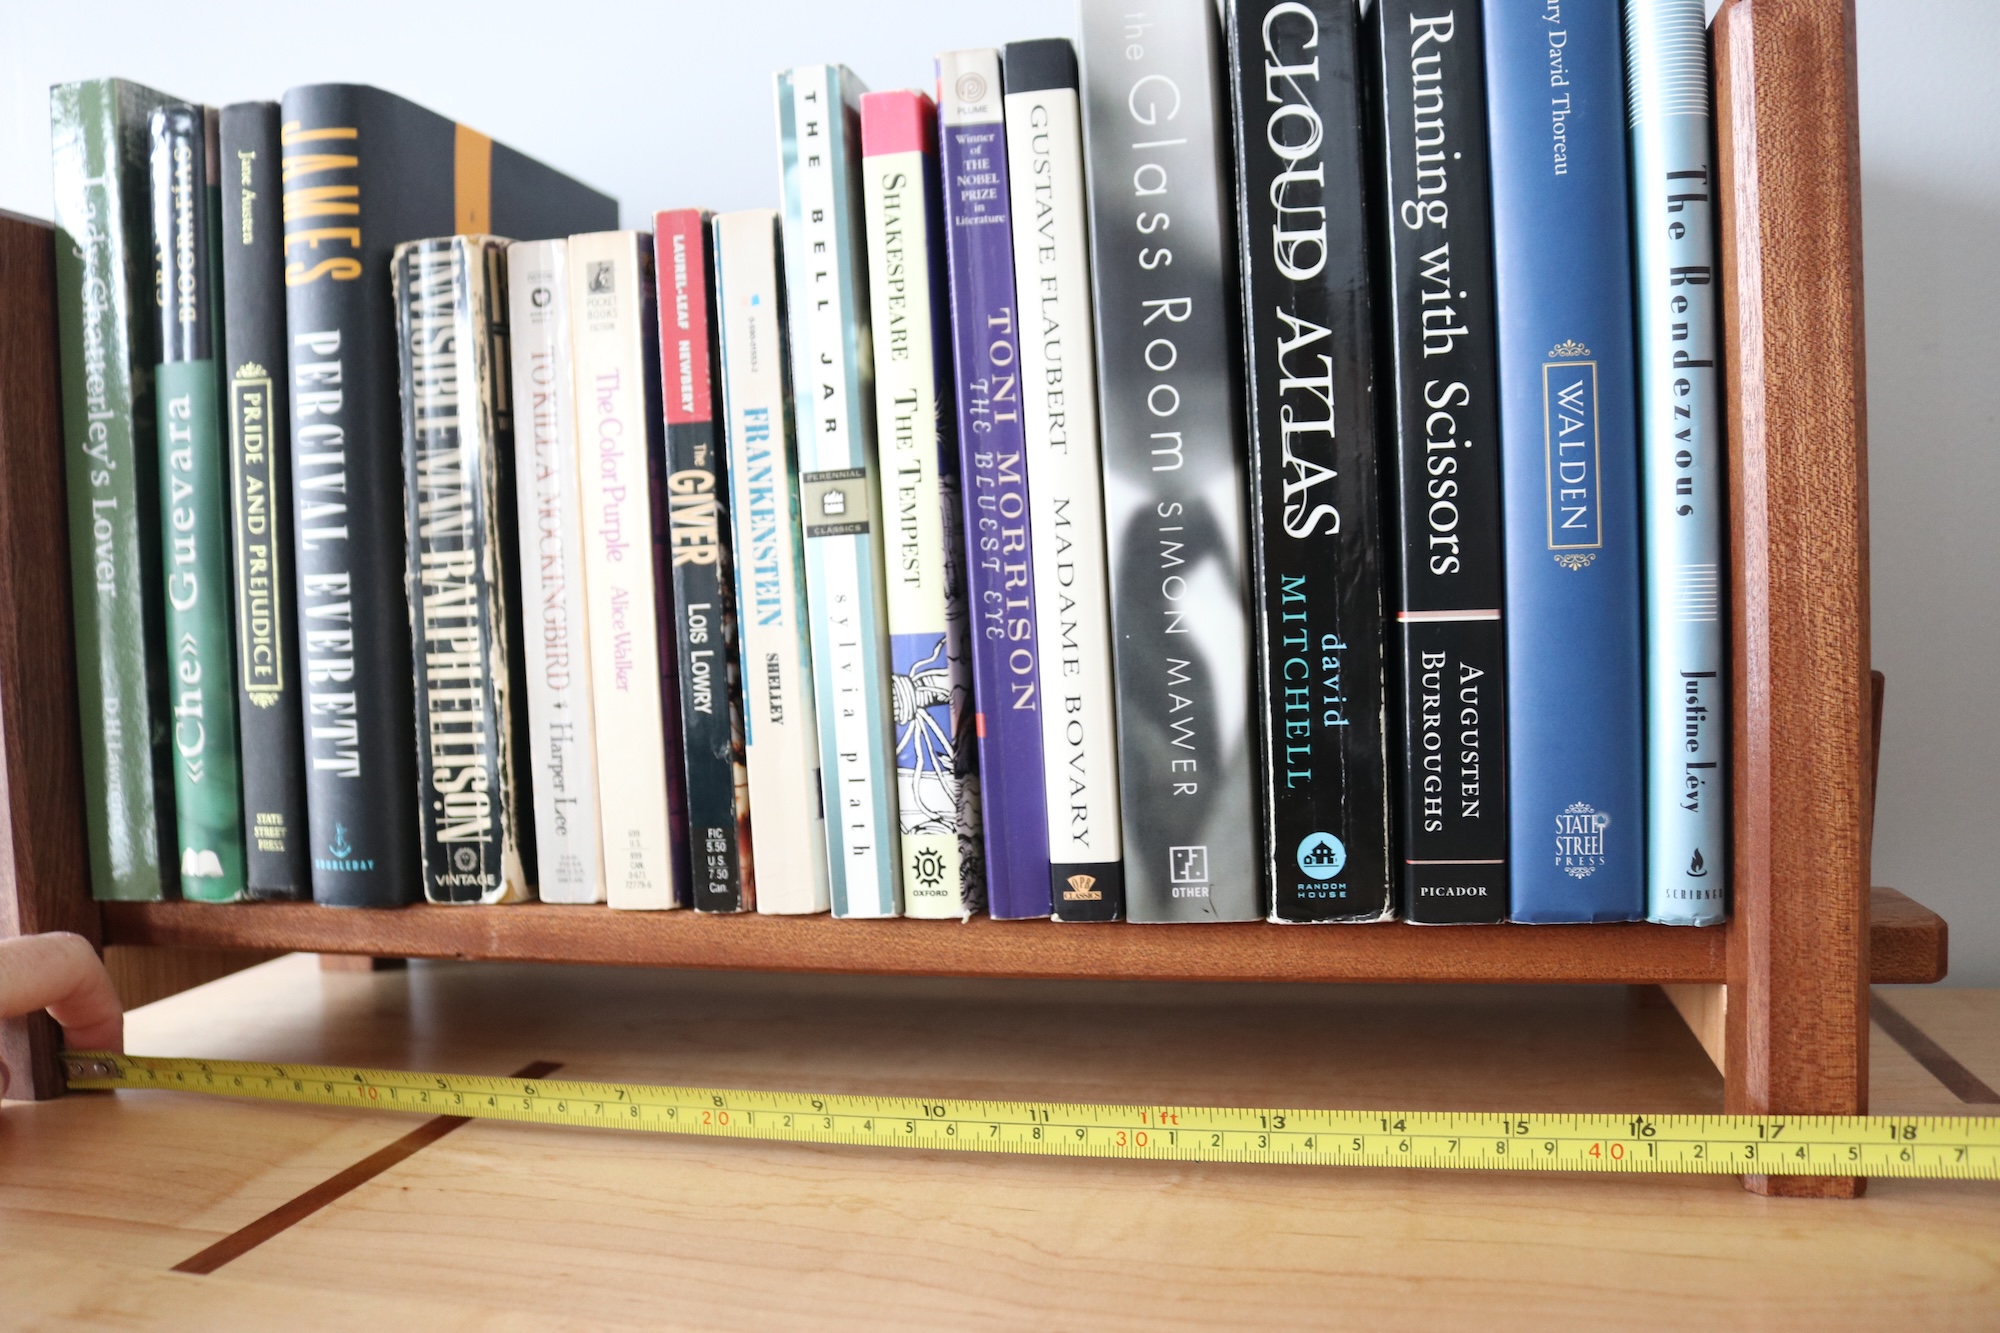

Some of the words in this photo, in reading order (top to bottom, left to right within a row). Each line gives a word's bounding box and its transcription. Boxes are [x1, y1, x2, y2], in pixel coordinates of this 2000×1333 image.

[1123, 12, 1155, 60] the
[1548, 29, 1570, 87] David
[804, 90, 821, 168] THE
[955, 133, 995, 143] Winner
[957, 105, 988, 114] PLUME
[1261, 1, 1328, 281] CLOUD
[1400, 10, 1462, 231] Running
[1551, 92, 1571, 176] Thoreau
[237, 150, 256, 188] Jane
[957, 173, 1000, 186] NOBEL
[963, 159, 990, 170] THE
[970, 144, 982, 155] of
[1030, 104, 1056, 265] GUSTAVE
[1128, 74, 1188, 270] Glass
[240, 189, 257, 246] Austen
[281, 120, 362, 288] JAMES
[955, 214, 1006, 226] Literature
[961, 189, 997, 202] PRIZE
[974, 202, 985, 213] in
[1666, 164, 1708, 241] The
[672, 234, 690, 330] LAUREL-LEAF
[811, 208, 829, 311] BELL
[587, 295, 618, 306] POCKET
[587, 308, 618, 320] BOOKS
[1419, 242, 1469, 359] with
[408, 248, 461, 441] INVISIBLE
[530, 346, 555, 385] TO
[678, 340, 695, 414] NEWBERY
[882, 173, 909, 361] SHAKESPEARE
[897, 459, 922, 589] TEMPEST
[987, 307, 1018, 423] TONI
[1040, 275, 1068, 455] FLAUBERT
[81, 277, 117, 488] Chatterley's
[596, 368, 620, 413] The
[820, 352, 837, 433] JAR
[970, 378, 992, 434] THE
[1141, 297, 1193, 472] Room
[1669, 265, 1714, 517] Rendezvous
[242, 392, 263, 465] PRIDE
[294, 328, 350, 552] PERCIVAL
[532, 391, 560, 457] KILL
[598, 417, 624, 482] Color
[693, 442, 707, 467] The
[1275, 305, 1341, 539] ATLAS
[1557, 379, 1588, 529] WALDEN
[169, 393, 198, 612] Guevara
[246, 476, 266, 535] AND
[416, 447, 475, 539] MAN
[536, 463, 558, 481] A
[806, 470, 862, 481] PERENNIAL
[1423, 379, 1473, 576] Scissors
[92, 496, 117, 599] Lover
[601, 485, 630, 563] Purple
[668, 469, 719, 566] GIVER
[743, 406, 783, 627] FRANKENSTEIN
[813, 524, 862, 535] CLASSICS
[974, 452, 1001, 573] BLUEST
[537, 491, 571, 691] MOCKINGBIRD
[996, 450, 1036, 711] MORRISON
[1053, 497, 1081, 677] MADAME
[1157, 501, 1189, 635] SIMON
[249, 545, 273, 678] PREJUDICE
[420, 549, 482, 681] RALPH
[611, 586, 630, 630] Alice
[687, 602, 711, 644] LOIS
[983, 590, 1005, 640] EYE
[303, 571, 361, 777] EVERETT
[612, 632, 633, 693] Walker
[690, 650, 714, 715] LOWRY
[765, 653, 784, 725] SHELLEY
[830, 593, 858, 718] sylvia
[1280, 573, 1312, 789] MITCHELL
[1320, 633, 1350, 728] david
[1166, 657, 1198, 796] MAWER
[1421, 650, 1446, 833] BURROUGHS
[1459, 661, 1485, 819] AUGUSTEN
[1680, 669, 1717, 753] Justine
[548, 721, 573, 793] Harper
[1064, 694, 1090, 849] BOVARY
[1680, 761, 1717, 813] Lévy
[253, 826, 287, 838] STREET
[256, 813, 283, 825] STATE
[554, 797, 577, 836] Lee
[840, 752, 870, 856] plath
[1555, 814, 1598, 834] STATE
[435, 873, 496, 887] VINTAGE
[1555, 830, 1605, 856] STREET
[1555, 856, 1605, 866] PRESS
[912, 889, 948, 897] OXFORD
[1172, 886, 1209, 898] OTHER
[1297, 882, 1347, 890] RANDOM
[1297, 891, 1347, 899] HOUSE
[1420, 886, 1488, 897] PICADOR
[274, 1067, 285, 1077] 3
[353, 1073, 363, 1084] 4
[437, 1079, 448, 1089] 5
[523, 1084, 535, 1095] 6
[614, 1090, 625, 1100] 7
[713, 1096, 724, 1107] 8
[811, 1100, 823, 1111] 9
[922, 1104, 946, 1118] 10
[1028, 1109, 1049, 1122] 11
[1259, 1115, 1286, 1130] 13
[1380, 1118, 1407, 1133] 14
[1503, 1120, 1529, 1135] 15
[1629, 1122, 1656, 1137] 16
[1758, 1124, 1785, 1139] 17
[1890, 1125, 1917, 1140] 18
[356, 1086, 378, 1101] 10
[522, 1098, 530, 1110] 5
[594, 1103, 601, 1115] 7
[702, 1111, 729, 1126] 20
[863, 1119, 872, 1132] 4
[946, 1123, 955, 1136] 6
[1032, 1127, 1041, 1140] 8
[1116, 1131, 1148, 1147] 30
[1211, 1134, 1220, 1148] 2
[1304, 1136, 1314, 1150] 4
[1399, 1138, 1409, 1153] 6
[1496, 1140, 1506, 1155] 8
[1588, 1143, 1625, 1160] 40
[1745, 1145, 1756, 1160] 3
[1848, 1147, 1858, 1162] 5
